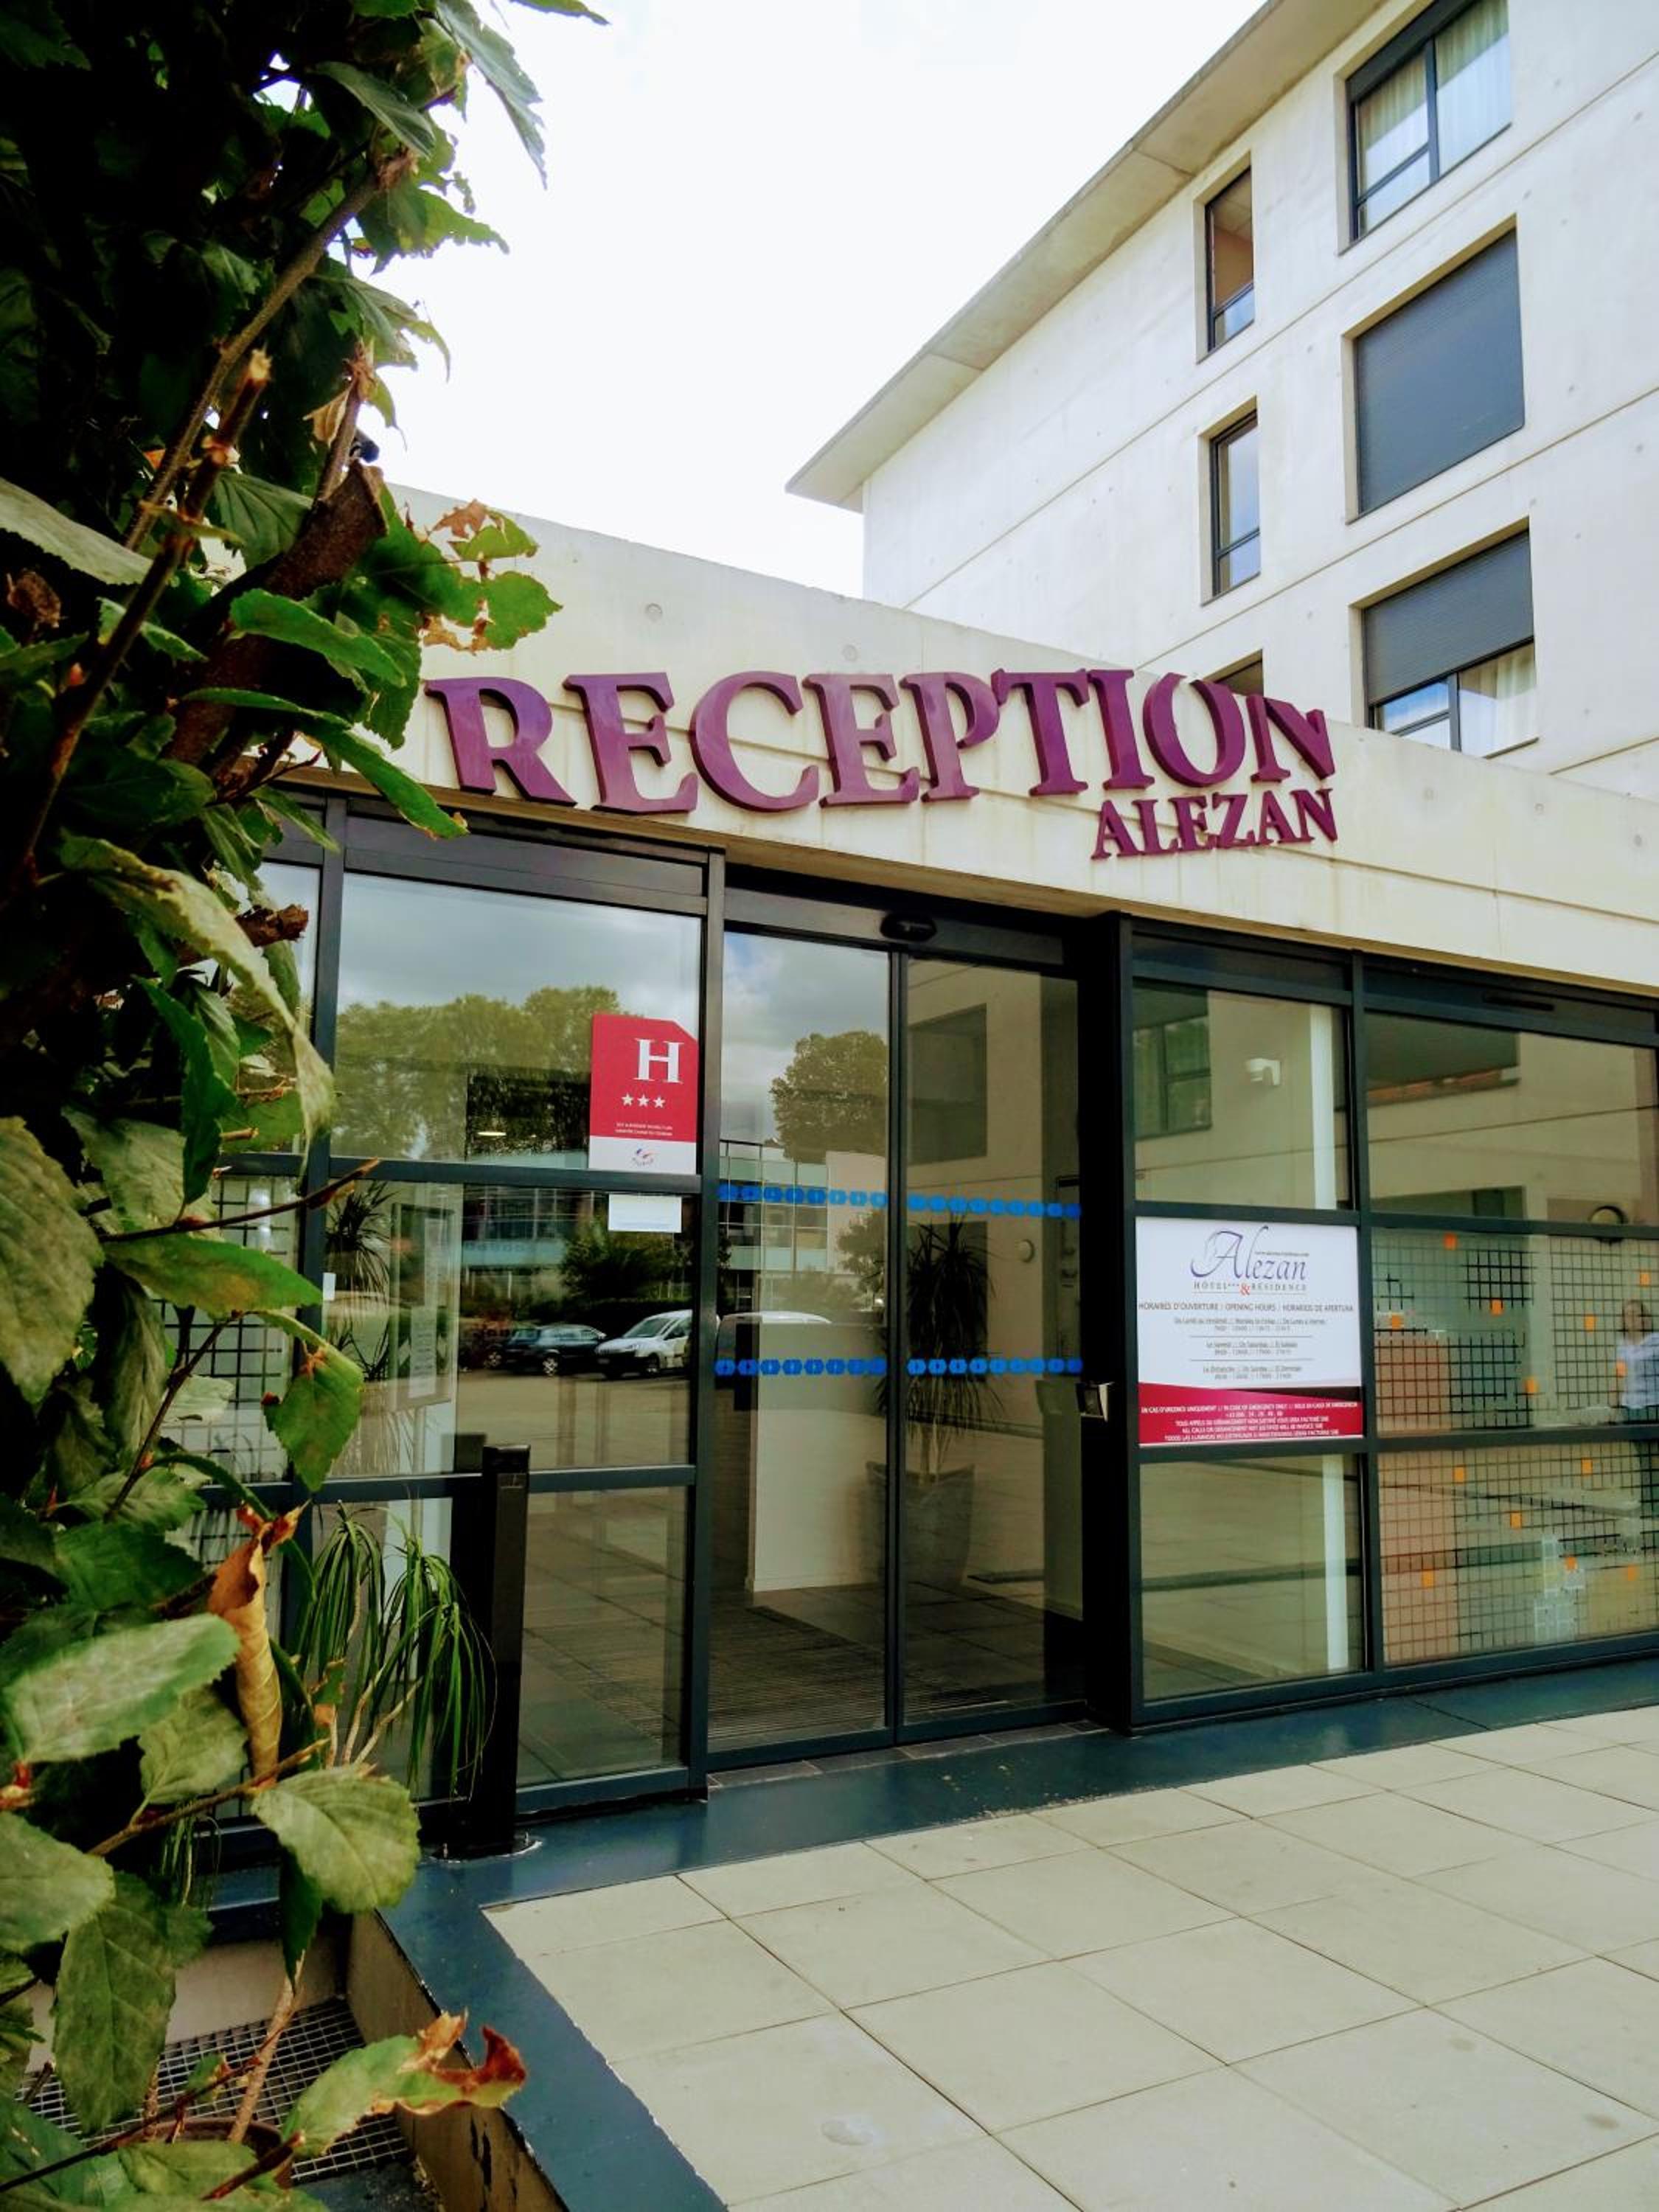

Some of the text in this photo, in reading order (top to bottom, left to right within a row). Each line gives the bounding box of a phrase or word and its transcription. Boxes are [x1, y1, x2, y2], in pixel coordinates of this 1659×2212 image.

[424, 668, 1335, 814] RECEPTION
[1091, 788, 1338, 860] ALEZAN
[634, 1038, 684, 1084] H
[1191, 1225, 1307, 1281] Alezan
